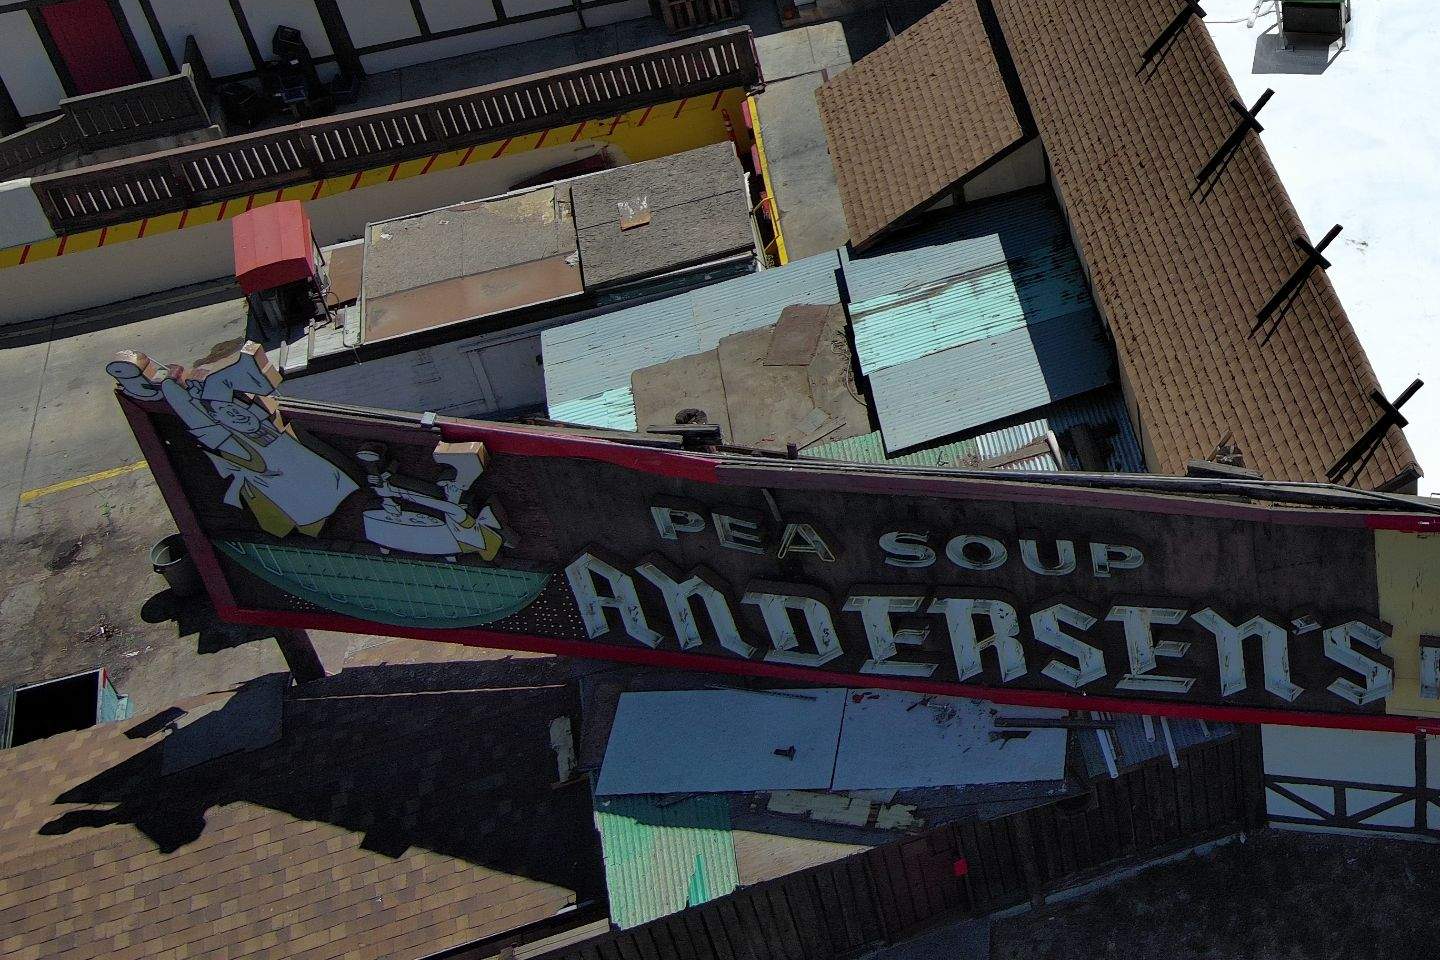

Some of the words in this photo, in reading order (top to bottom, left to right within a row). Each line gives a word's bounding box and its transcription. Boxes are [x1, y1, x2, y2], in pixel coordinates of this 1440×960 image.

[651, 506, 835, 562] PEA
[879, 529, 1145, 577] SOUP
[564, 552, 1394, 706] ANDERSEN'S
